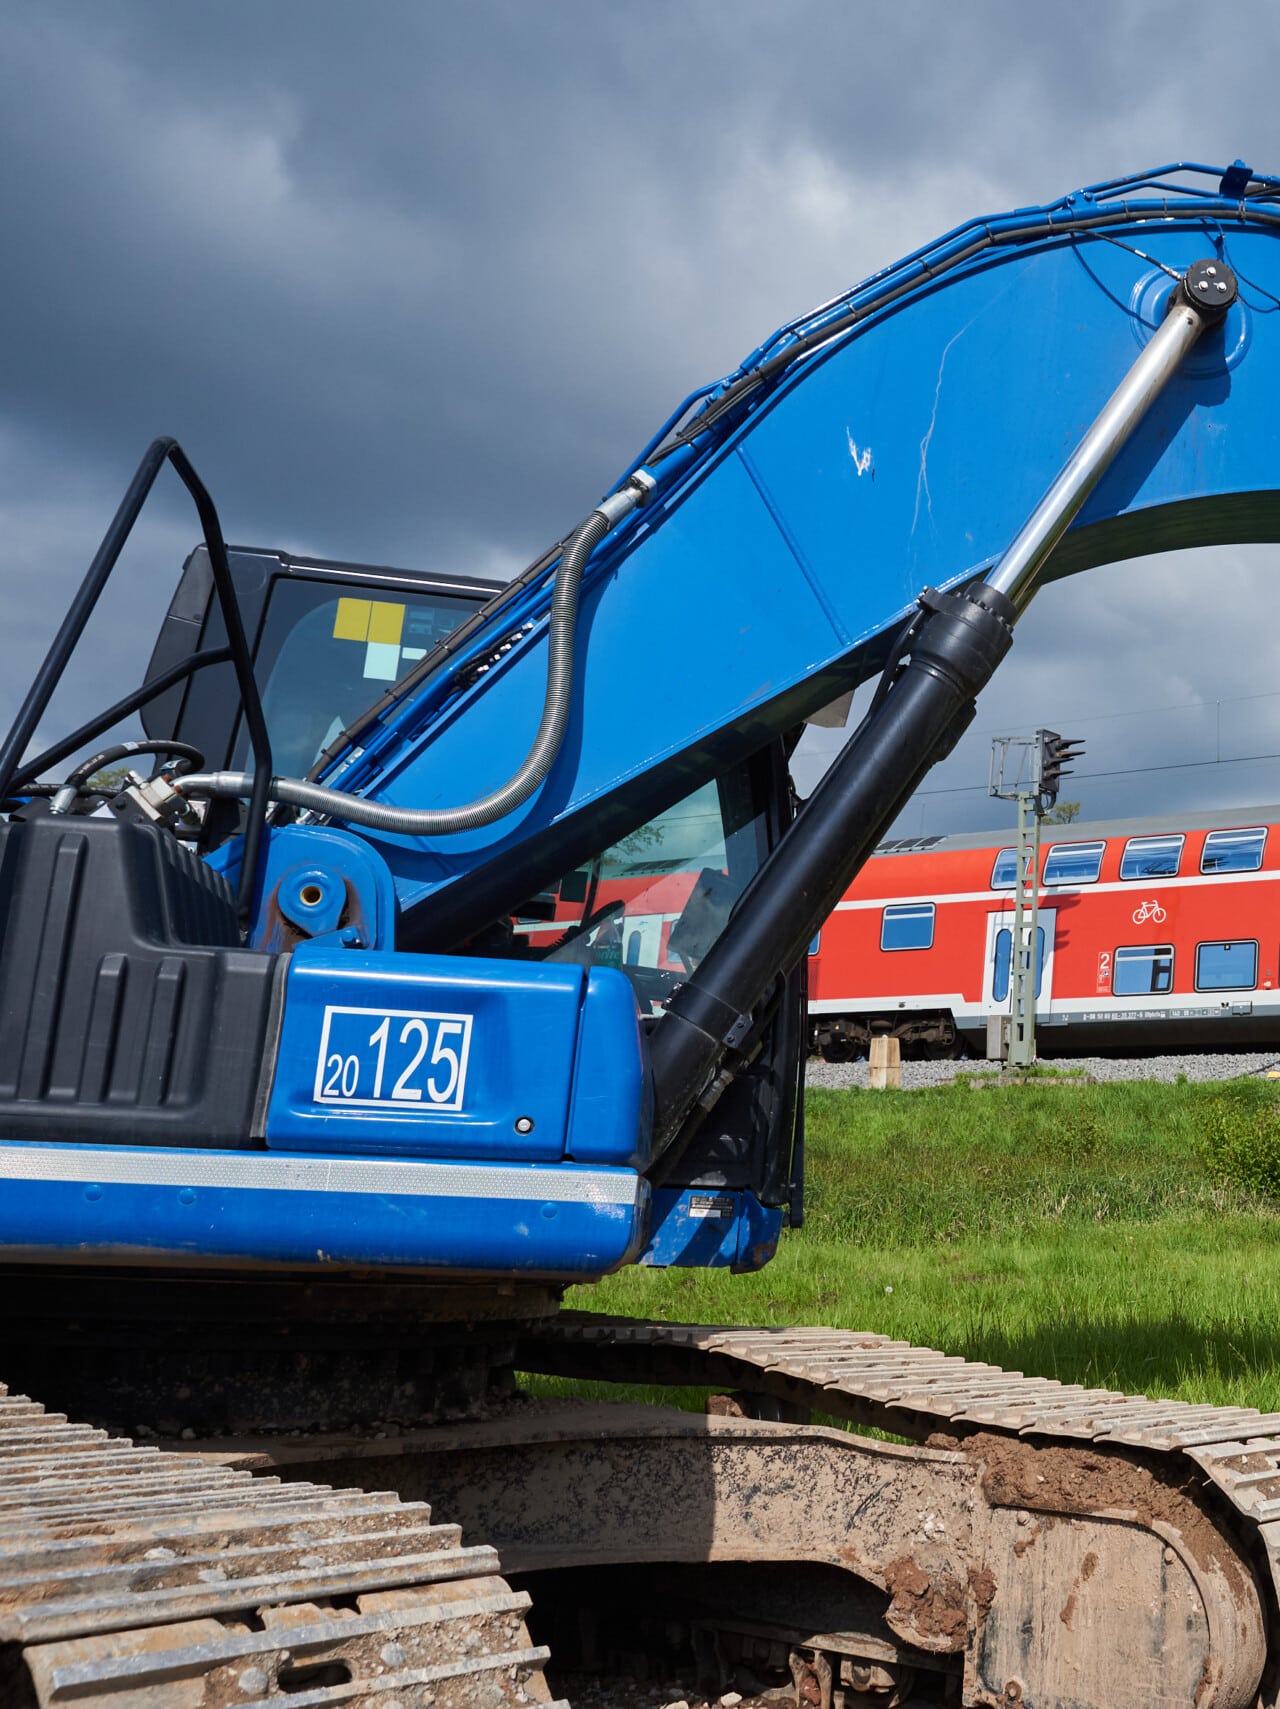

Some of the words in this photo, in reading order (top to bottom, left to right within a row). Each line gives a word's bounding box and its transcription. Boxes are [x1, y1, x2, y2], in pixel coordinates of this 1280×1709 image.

[1100, 953, 1110, 970] 2
[323, 1054, 359, 1097] 20
[369, 1017, 462, 1103] 125
